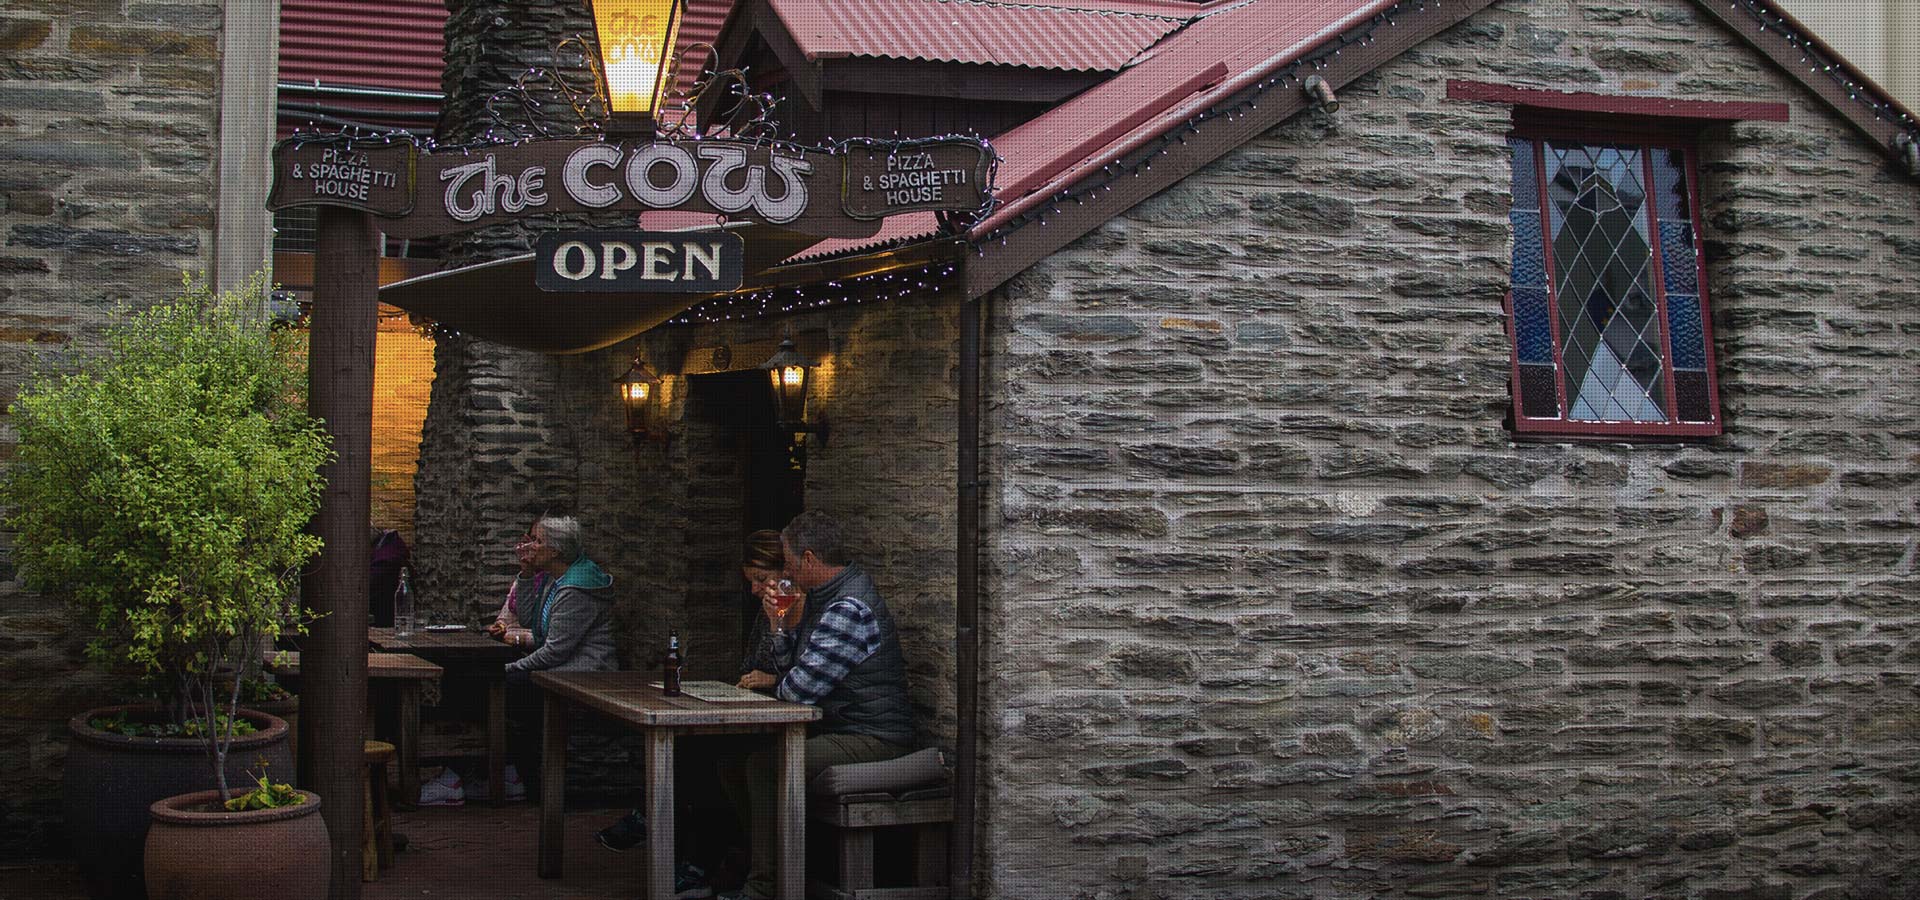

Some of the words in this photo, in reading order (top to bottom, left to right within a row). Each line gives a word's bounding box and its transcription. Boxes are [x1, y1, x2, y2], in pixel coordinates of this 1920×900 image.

[887, 153, 935, 171] PIZZA
[292, 163, 303, 179] &
[309, 163, 396, 188] SPAGHETTI
[863, 175, 874, 191] &
[879, 169, 966, 190] SPAGHETTI
[315, 179, 369, 201] HOUSE
[440, 153, 548, 222] The
[887, 186, 942, 206] HOUSE
[553, 240, 723, 282] OPEN
